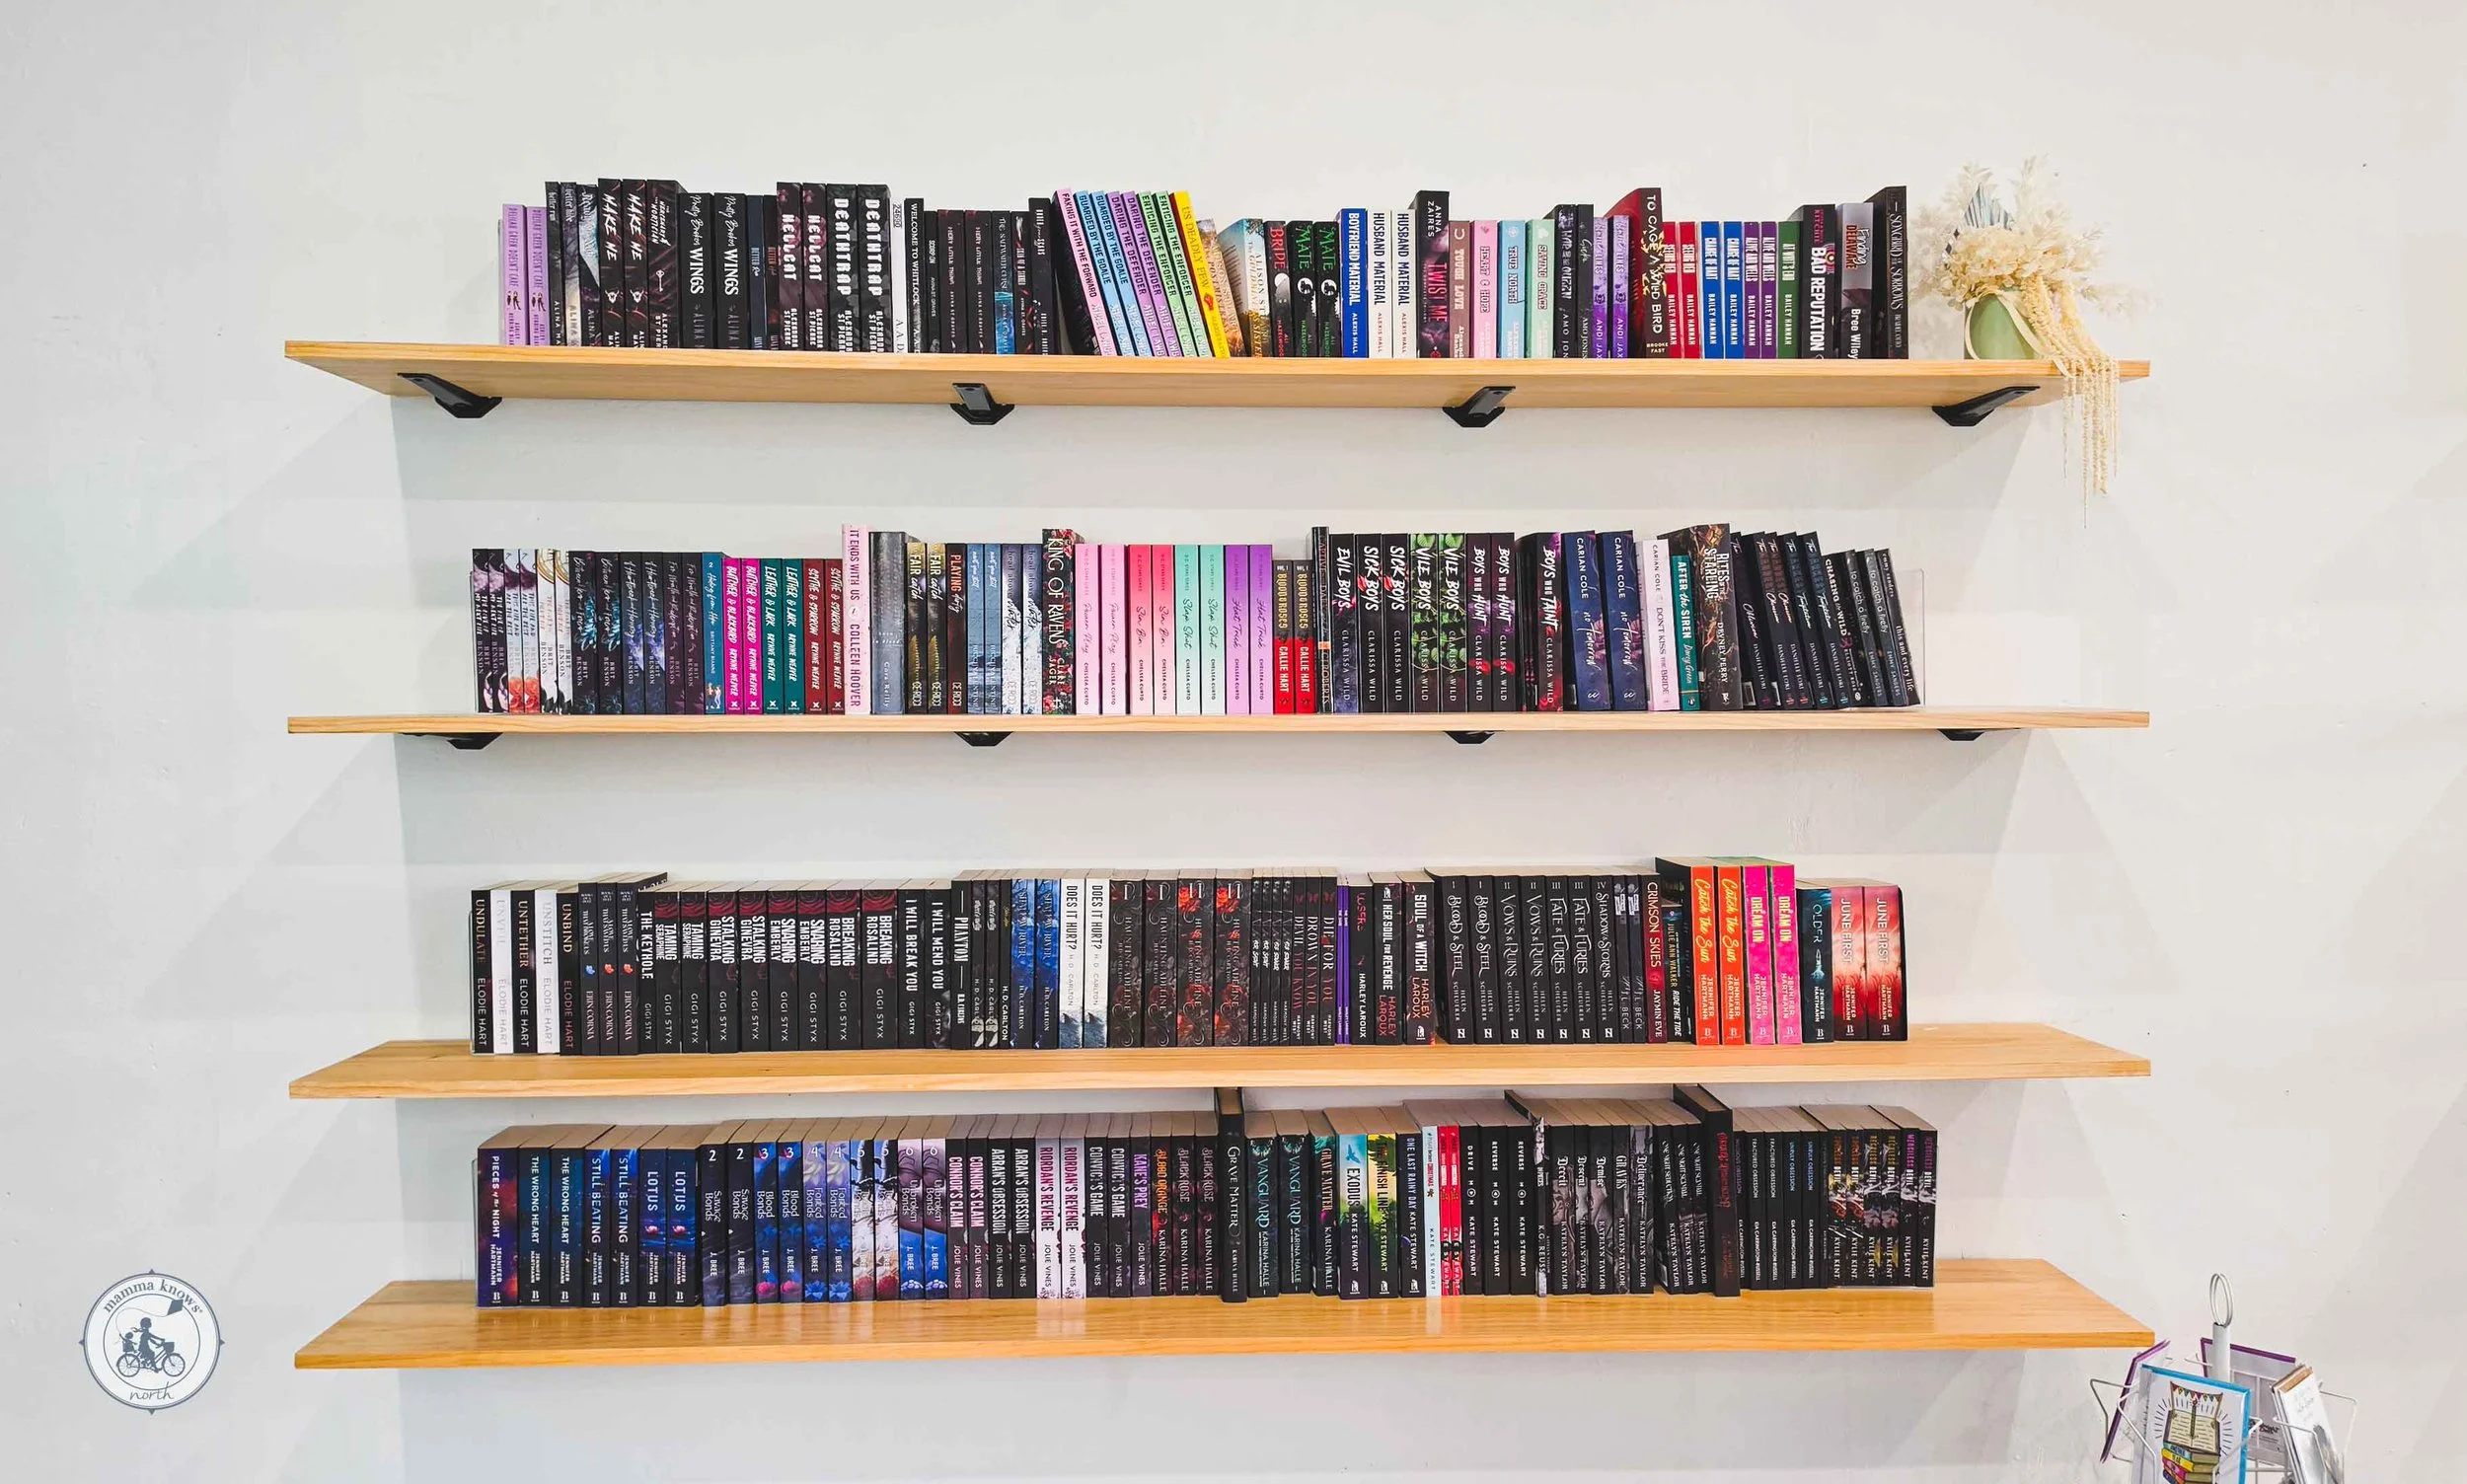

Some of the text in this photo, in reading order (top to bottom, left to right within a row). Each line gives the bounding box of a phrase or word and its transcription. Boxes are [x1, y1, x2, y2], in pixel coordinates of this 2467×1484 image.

[603, 192, 618, 260] MAKE ME
[782, 214, 797, 280] HELLCAT
[807, 215, 823, 281] HELLCAT
[834, 198, 852, 296] DEATHTRAP
[864, 198, 883, 296] DEATHTRAP
[910, 203, 919, 247] WELCOME
[1062, 192, 1097, 297] FAKING IT WITH THE FORWARD
[1079, 195, 1111, 285] GUARDED BY THE GOALIE
[1111, 196, 1147, 295] DARING THE DEFENDER
[1142, 195, 1176, 296] ENTICING THE ENFORCER
[1269, 226, 1284, 270] BRIDE
[1295, 225, 1312, 270] MATE
[689, 248, 705, 294] WINGS
[911, 248, 919, 260] TO
[1348, 212, 1361, 307] BOYFRIEND MATERIAL
[1373, 212, 1385, 306] HUSBAND MATERIAL
[1646, 194, 1663, 334] TO CAGE A WILD BIRD
[1427, 261, 1448, 323] TWIST ME
[1810, 248, 1827, 351] BAD REPUTATION
[1847, 308, 1861, 359] Bree Wiley
[764, 565, 777, 597] LEATHER
[909, 555, 924, 601] FAIR catch
[947, 555, 964, 614] PLAYING dirty
[1336, 547, 1354, 574] EVIL
[1362, 546, 1380, 612] SICK BOYS
[1576, 537, 1589, 599] CARIAN COLE
[1704, 548, 1718, 599] STARLING
[1716, 553, 1730, 582] RITES
[1047, 538, 1066, 644] KING OF RAVENS
[1336, 577, 1351, 609] BOYS
[1471, 545, 1487, 628] BOYS WHO HUNT
[1678, 561, 1691, 639] AFTER the SIREN
[765, 607, 776, 628] LARK
[850, 530, 860, 706] IT ENDS WITH US COLLEEN HOOVER
[767, 632, 776, 657] BRYNNE
[768, 658, 777, 682] WEAVER
[1278, 646, 1289, 693] CALLIE HART
[561, 904, 572, 953] UNBIND
[905, 906, 918, 931] WILL
[1066, 885, 1078, 950] DOES IT HURT?
[1383, 904, 1393, 920] HER
[1414, 894, 1427, 923] SOUL
[1647, 882, 1659, 933] CRIMSON
[1813, 904, 1824, 943] OLDER
[640, 911, 653, 980] THE KEYHOLE
[691, 923, 704, 960] TAMING
[710, 920, 722, 961] GINEVRA
[721, 916, 735, 964] STALKING
[770, 920, 782, 962] EMBERLY
[781, 918, 795, 964] SNARING
[829, 918, 841, 967] ROSALIND
[842, 917, 856, 966] BREAKING
[906, 934, 918, 968] BREAK
[1383, 921, 1393, 943] SOUL
[1415, 940, 1428, 972] WITCH
[1650, 937, 1661, 968] SKIES
[518, 900, 529, 1048] UNTETHER ELODIE HART
[906, 971, 918, 992] YOU
[1383, 955, 1393, 991] REVENGE
[1379, 995, 1388, 1036] LAROUX
[1387, 996, 1397, 1036] HARLEY
[491, 1156, 500, 1189] PIECES
[531, 1175, 540, 1212] WRONG
[647, 1171, 659, 1212] LOTUS
[948, 1156, 964, 1227] CONNOR'S CLAIM
[992, 1149, 1007, 1234] ARRAN'S OBSESSION
[1040, 1147, 1055, 1231] RIORDAN'S REVENGE
[1134, 1153, 1148, 1209] KANE'S PREY
[1347, 1167, 1361, 1207] EXODUS
[491, 1210, 500, 1238] NIGHT
[591, 1157, 601, 1243] STILL BEATING
